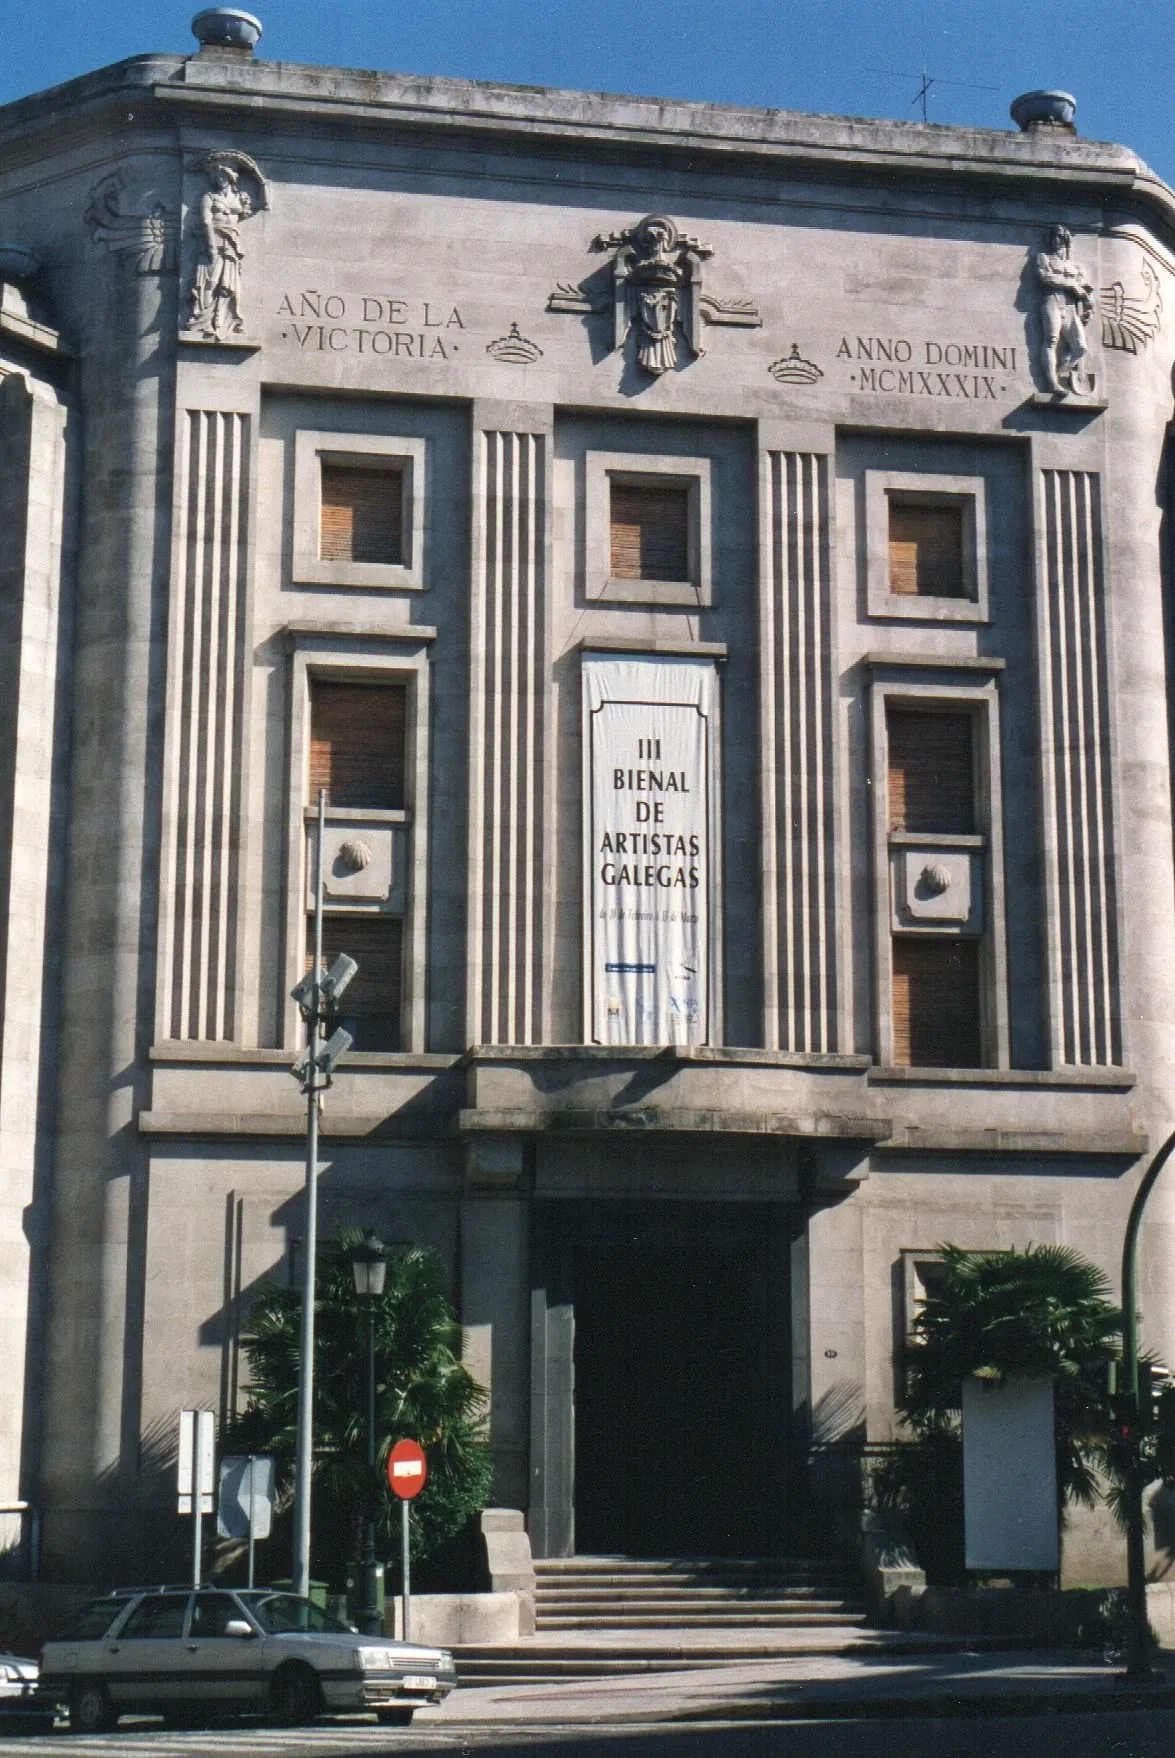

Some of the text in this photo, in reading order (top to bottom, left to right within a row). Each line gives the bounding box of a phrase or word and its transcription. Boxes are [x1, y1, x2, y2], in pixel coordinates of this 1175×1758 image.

[276, 290, 466, 329] AÑO DE LA
[835, 336, 1017, 371] ANNO DOMINI
[638, 738, 661, 760] III
[613, 768, 690, 793] BIENAL
[636, 801, 664, 823] DE
[600, 832, 700, 857] ARTISTAS
[601, 863, 700, 889] GALEGAS
